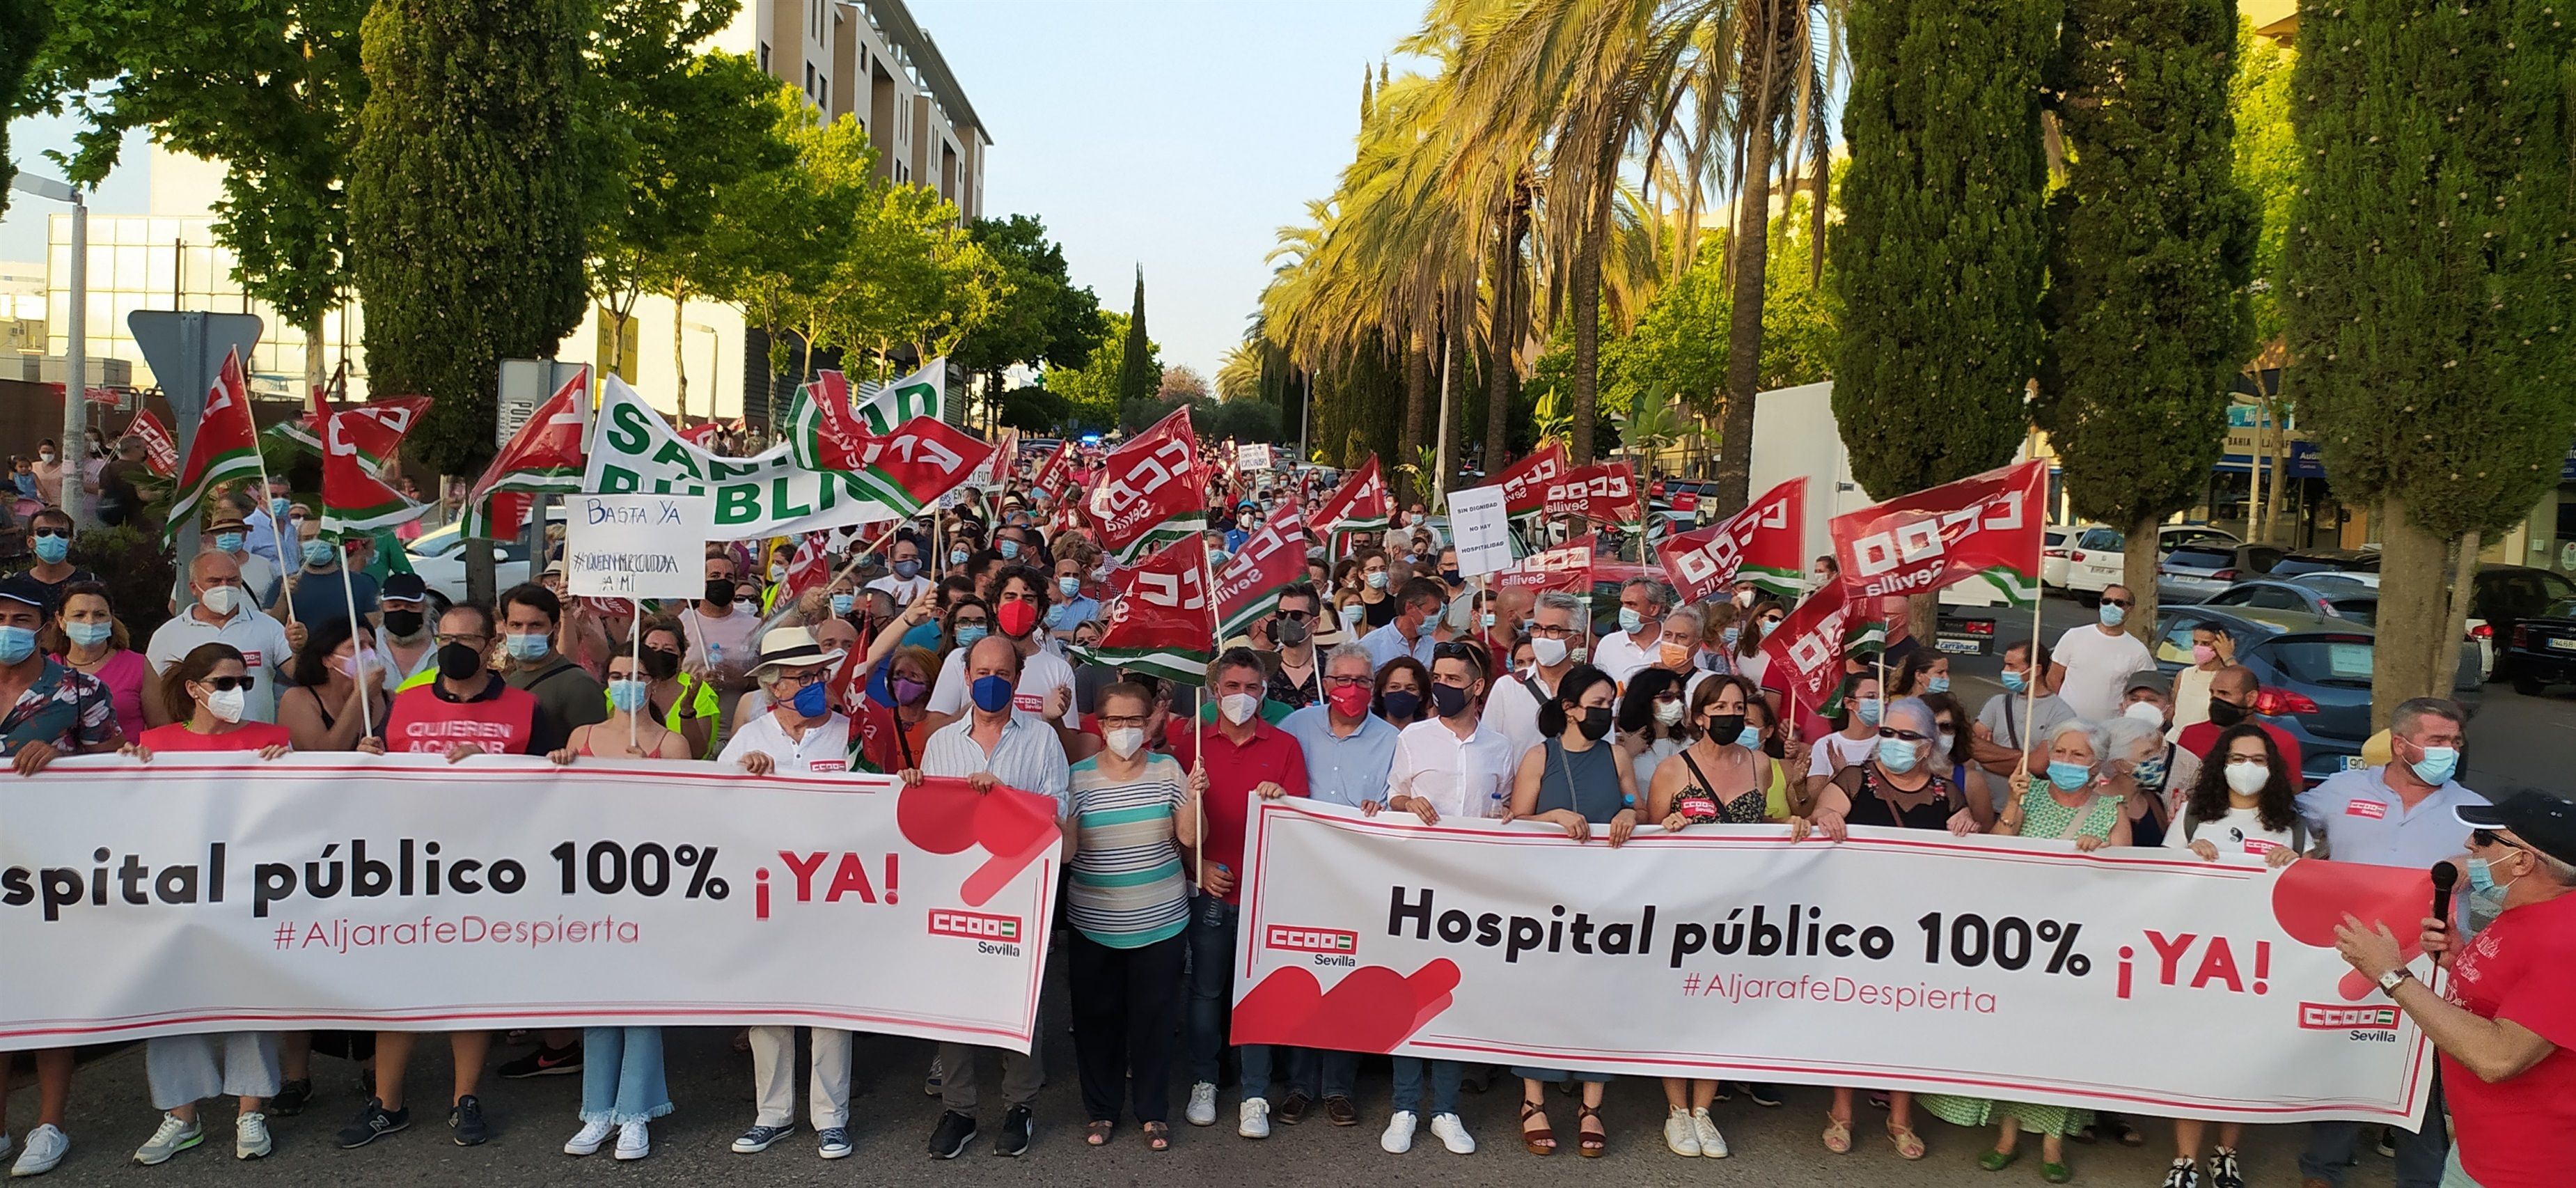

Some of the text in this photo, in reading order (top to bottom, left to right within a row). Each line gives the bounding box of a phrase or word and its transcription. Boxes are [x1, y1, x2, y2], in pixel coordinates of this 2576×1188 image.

[587, 498, 682, 526] BASTA YA
[1469, 501, 1498, 513] DIGNIDAD
[1461, 540, 1505, 554] HOSPITALIDAD
[405, 720, 514, 738] QUIEREN
[1, 838, 900, 922] spital público 100% ¡YA!
[272, 914, 640, 954] #AljarafeDespierta
[933, 913, 999, 937] CCOO
[1271, 929, 1336, 949] CCOO
[1387, 885, 2270, 1000] Hospital público 100% ¡YA!
[977, 941, 1021, 958] Sevilla
[1314, 953, 1356, 967] Sevilla
[1681, 971, 1997, 1014] #AljarafeDespierta
[2304, 1007, 2377, 1026] CCOO
[2349, 1030, 2396, 1042] Sevilla
